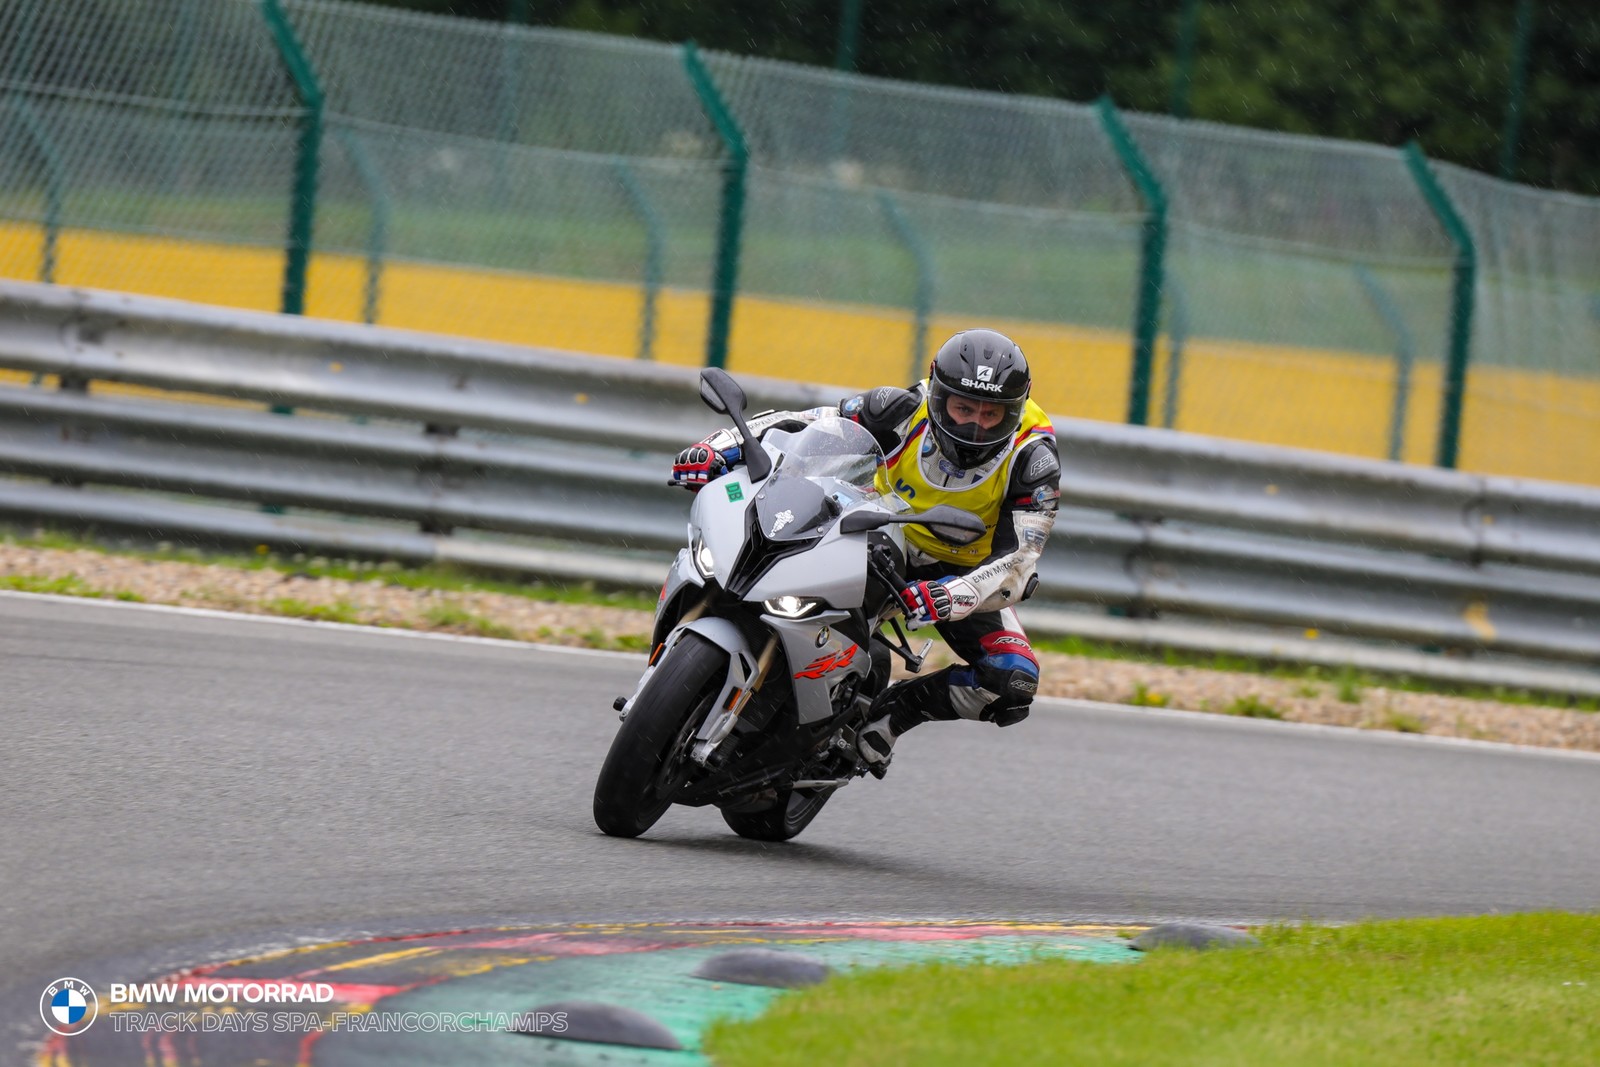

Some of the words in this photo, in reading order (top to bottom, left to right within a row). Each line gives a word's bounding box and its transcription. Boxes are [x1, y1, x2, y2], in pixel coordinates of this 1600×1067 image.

[961, 377, 1003, 392] SHARK
[726, 485, 744, 500] DB
[895, 477, 916, 499] S
[972, 569, 994, 584] BMW
